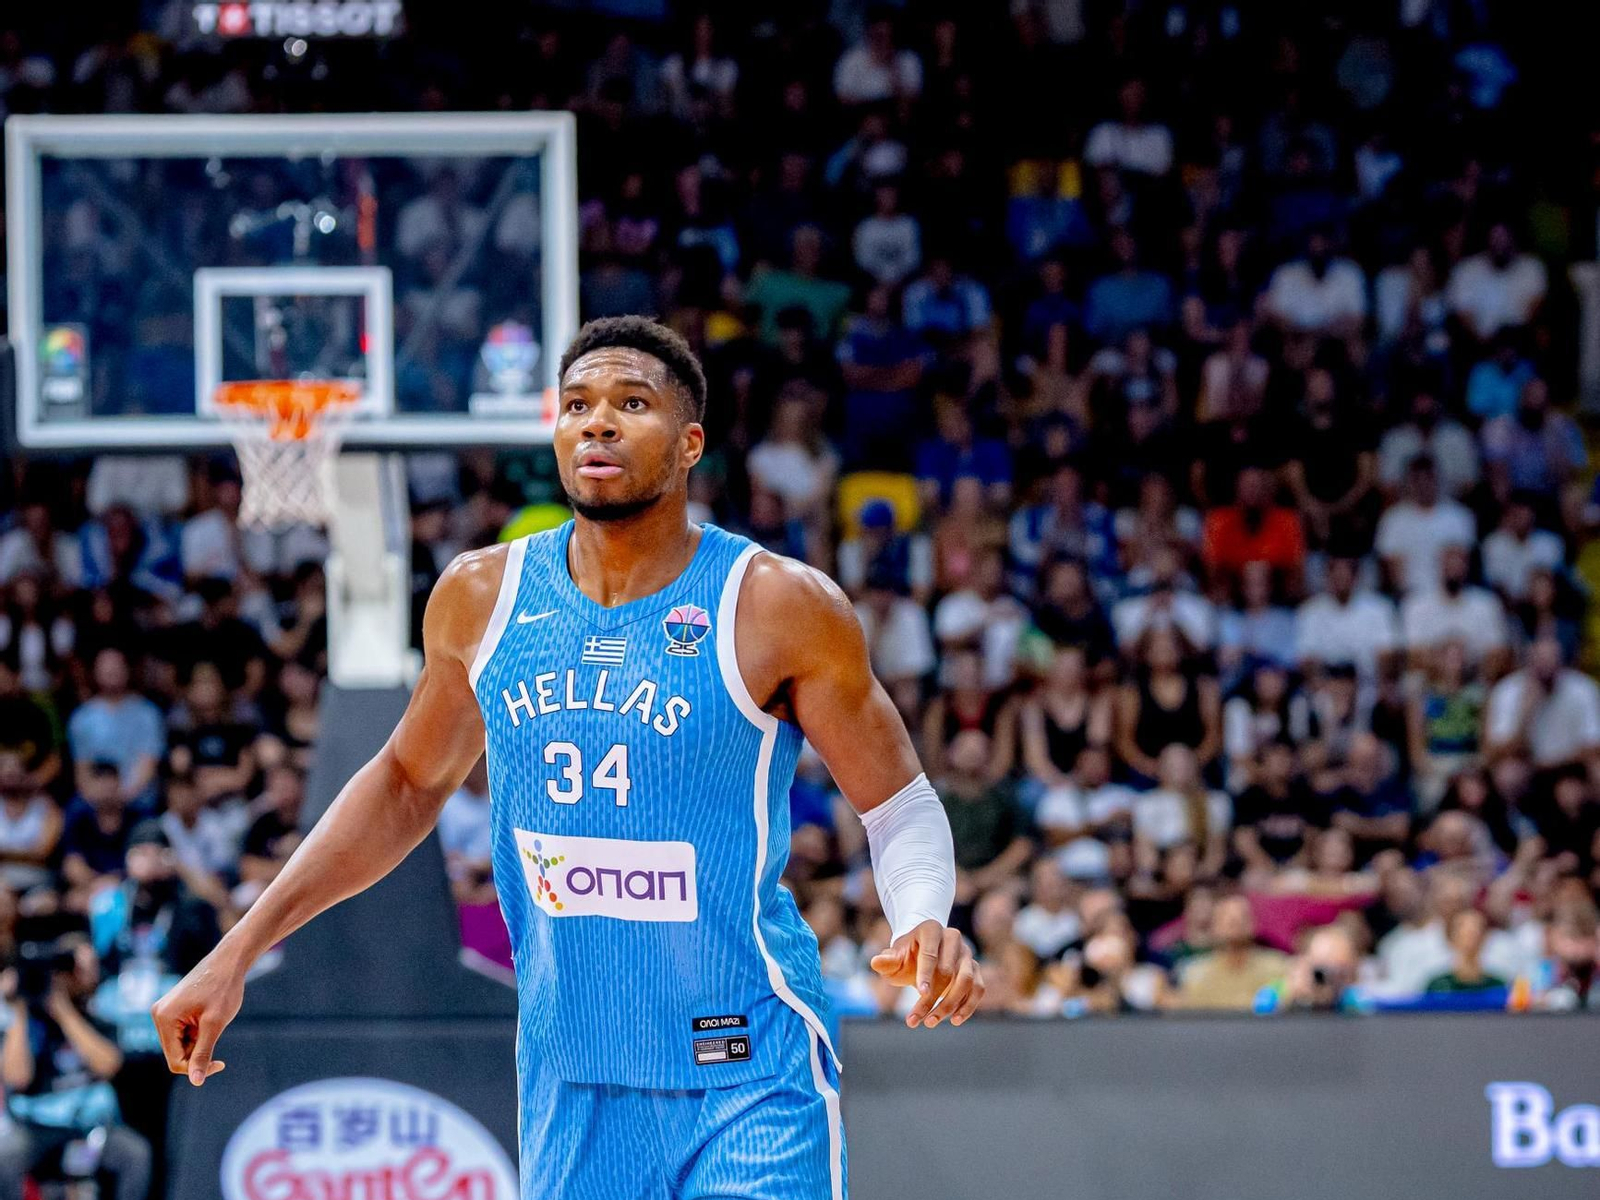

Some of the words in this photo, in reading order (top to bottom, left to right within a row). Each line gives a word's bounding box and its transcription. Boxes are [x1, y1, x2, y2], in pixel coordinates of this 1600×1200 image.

[501, 668, 692, 737] HELLAS
[542, 741, 631, 807] 34
[731, 1043, 745, 1053] 50
[1484, 1080, 1600, 1168] Ba
